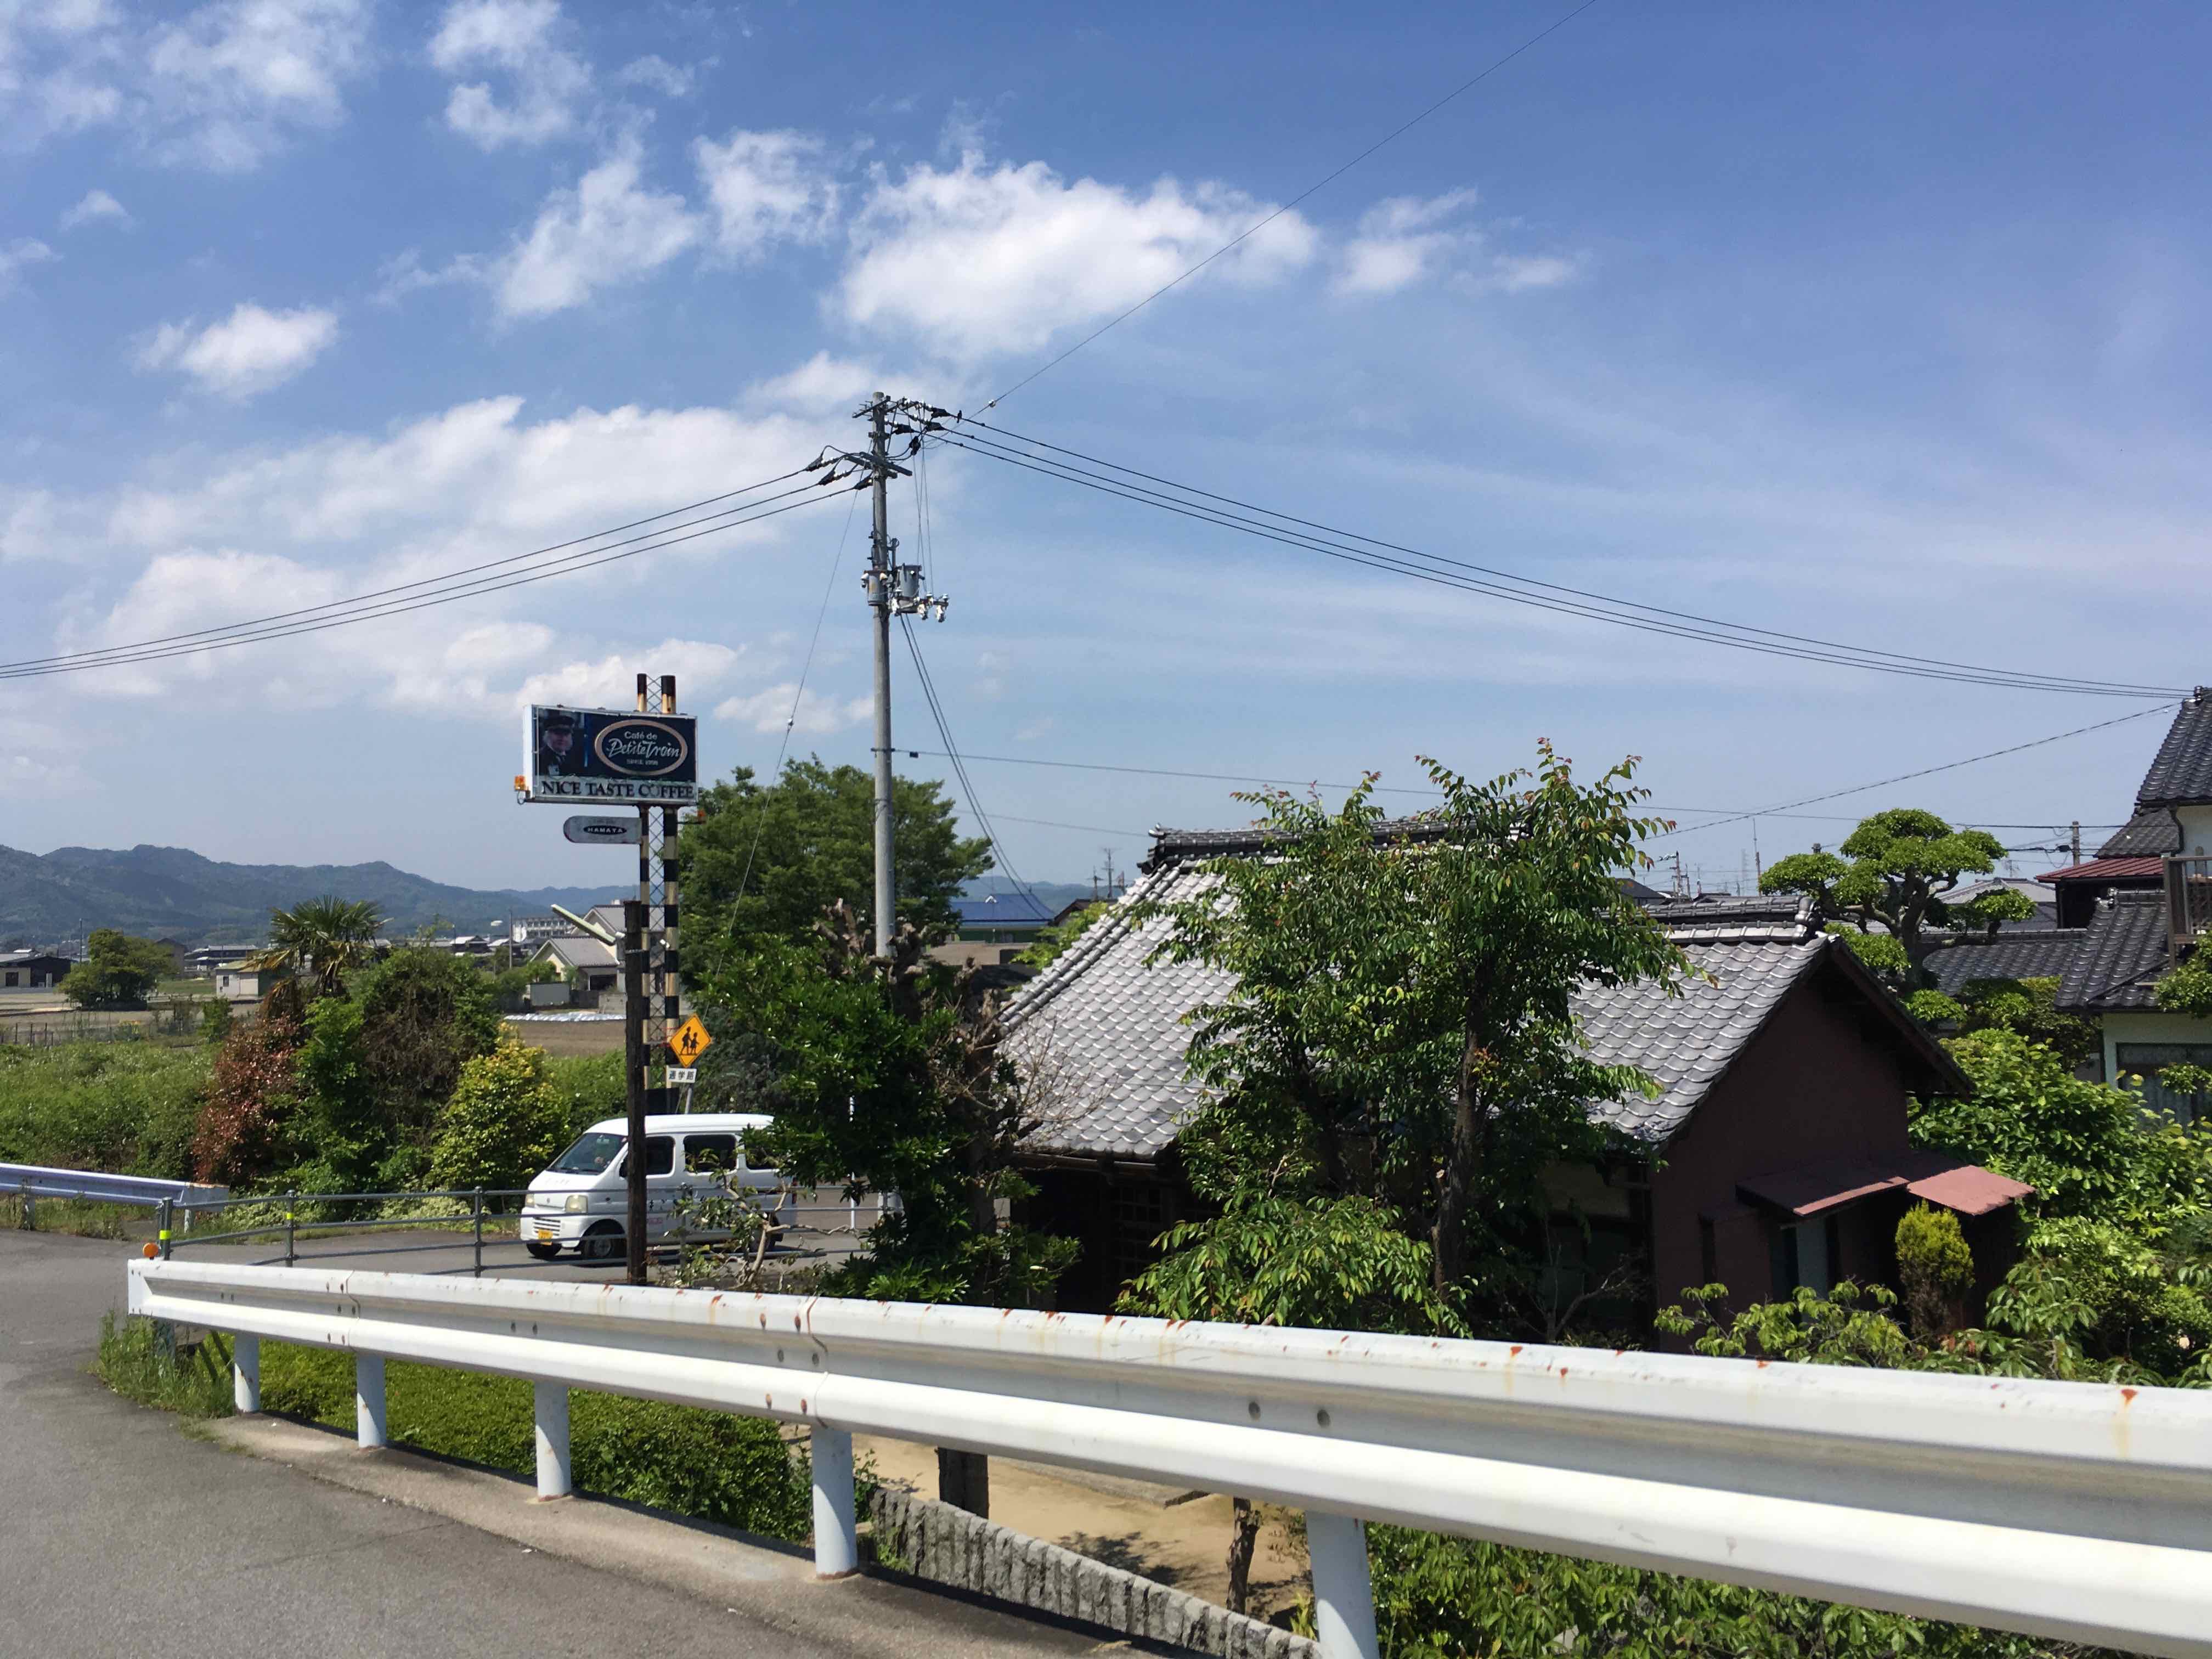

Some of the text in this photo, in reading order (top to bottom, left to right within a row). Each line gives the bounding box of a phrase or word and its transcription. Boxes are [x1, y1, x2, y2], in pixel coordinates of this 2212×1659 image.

[624, 731, 645, 740] Café
[541, 781, 581, 795] NICE
[585, 782, 635, 797] TASTE
[669, 1070, 695, 1080] 通学路
